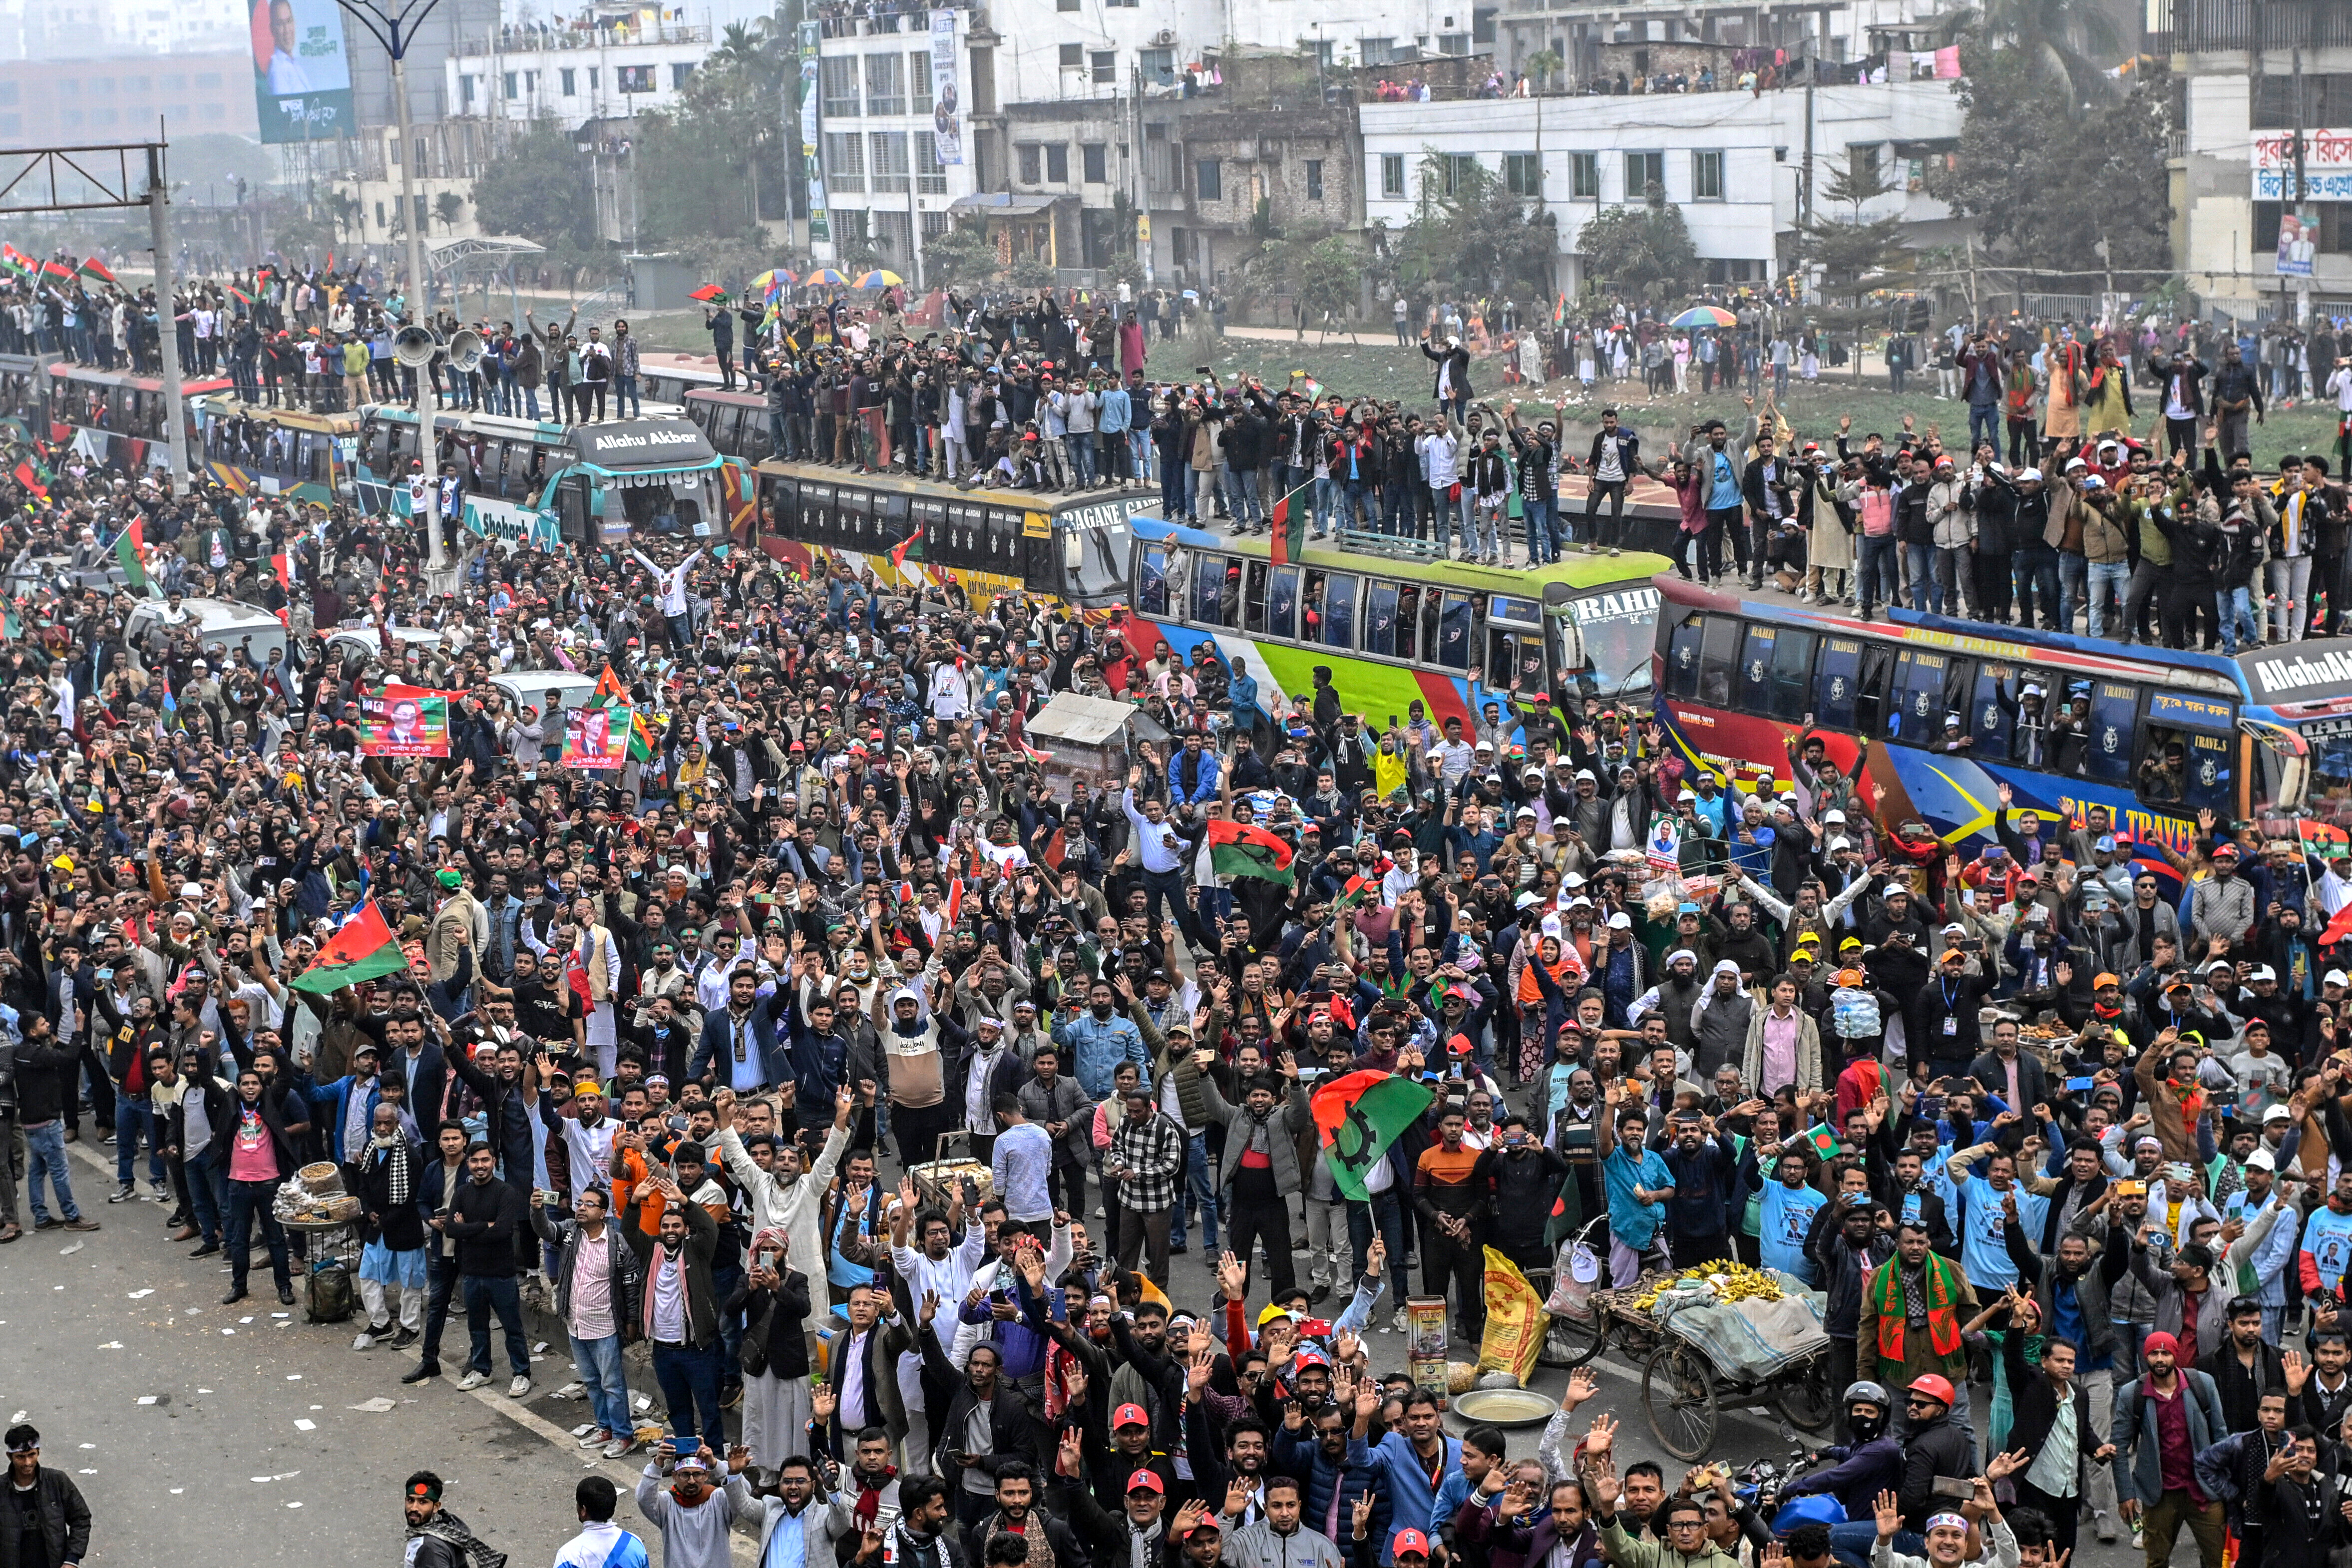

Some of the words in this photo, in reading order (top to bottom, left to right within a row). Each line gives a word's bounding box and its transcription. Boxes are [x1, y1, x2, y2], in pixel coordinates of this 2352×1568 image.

[596, 433, 647, 450] Allahu
[649, 430, 697, 445] Akbar
[816, 488, 830, 496] GANDHA
[911, 501, 925, 510] RAJNI
[927, 504, 942, 513] GANDHA
[948, 507, 964, 515] RAJNI
[965, 509, 981, 518] GANDHA
[989, 511, 1004, 520] RAJNI
[1006, 514, 1022, 523] GANDHA
[483, 512, 529, 541] Shohagh
[1206, 556, 1224, 564] TRAVELS
[1278, 567, 1295, 576] TRAVELS
[1376, 582, 1395, 591] TRAVELS
[1448, 593, 1469, 602] TRAVELS
[1689, 617, 1702, 627] HIL
[1751, 626, 1776, 640] RAHIL
[1522, 636, 1543, 646] TRAVELS
[1832, 640, 1858, 653] TRAVELS
[1917, 654, 1944, 668] TRAVELS
[1984, 665, 2013, 679] TRLS
[2104, 686, 2135, 700] TRAVELS
[1678, 711, 1715, 728] WELCOME-2023
[1746, 762, 1774, 775] JOURNEY
[2064, 797, 2117, 831] RAL
[2126, 809, 2196, 852] TRAVEL
